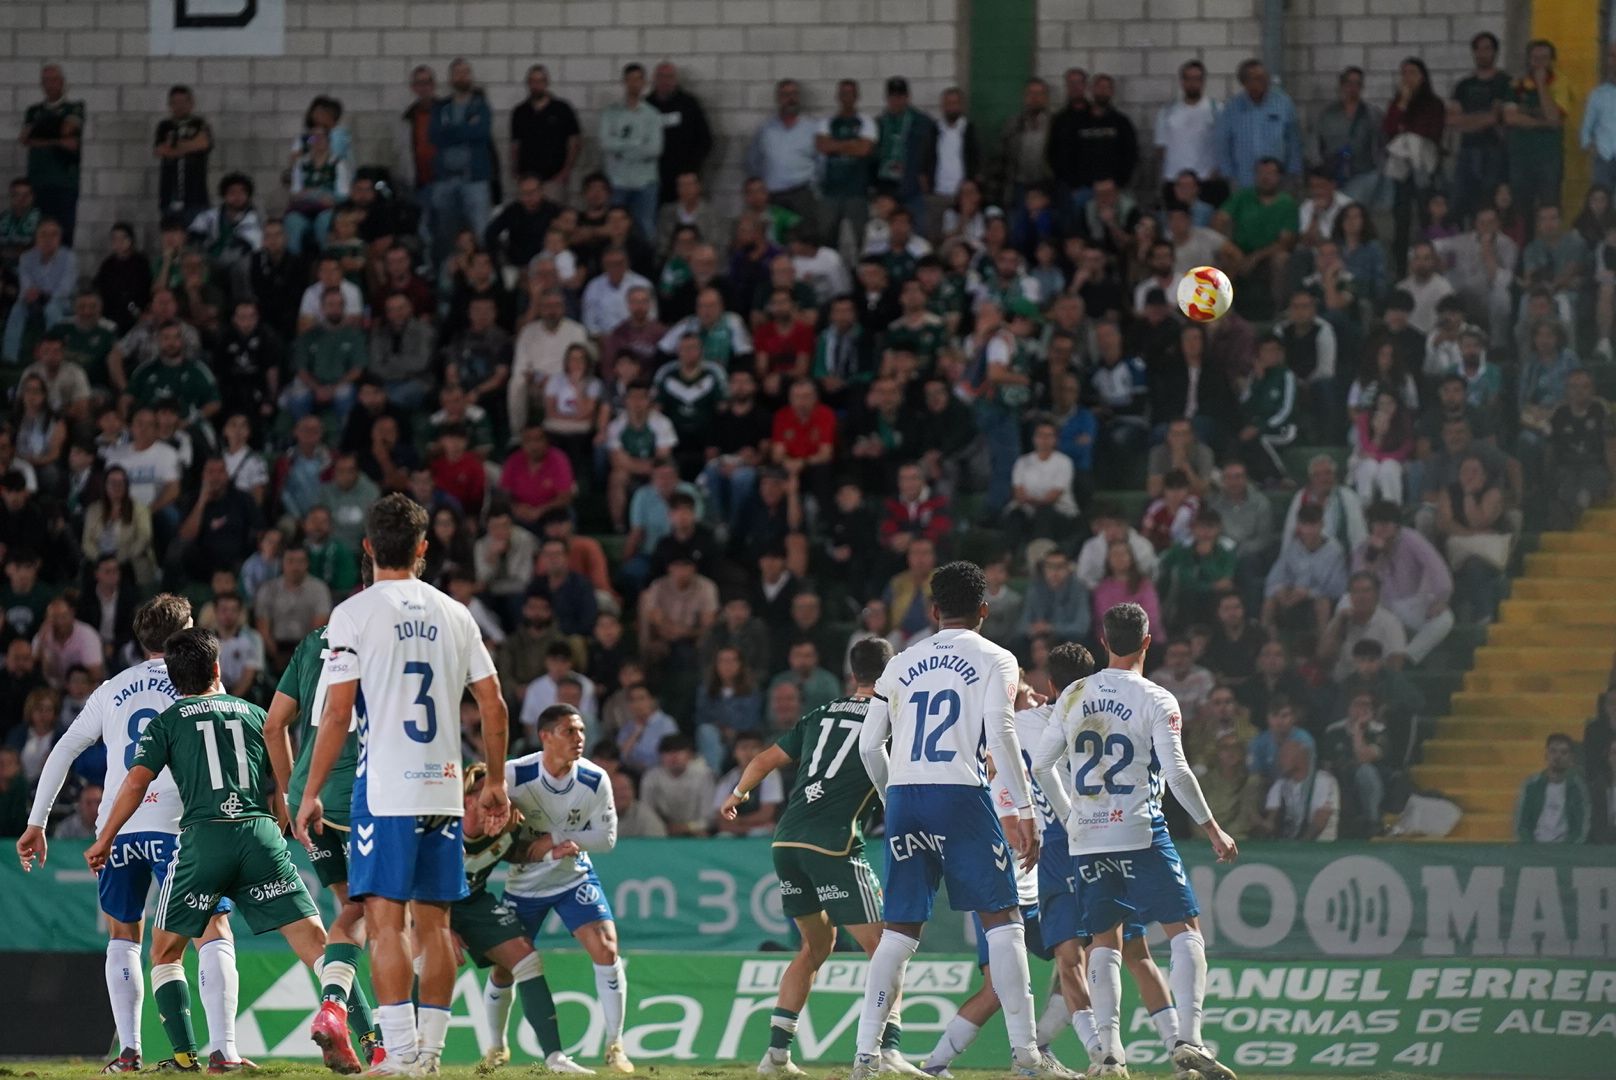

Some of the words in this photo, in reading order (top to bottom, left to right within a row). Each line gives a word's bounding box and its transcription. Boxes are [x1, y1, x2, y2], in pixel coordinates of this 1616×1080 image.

[394, 620, 438, 641] ZOILO
[899, 655, 979, 687] LANDAZURI
[113, 679, 144, 707] JAVI
[147, 676, 185, 701] PÉRE
[403, 661, 438, 744] 3
[1082, 699, 1132, 721] ÁLVARO
[909, 689, 961, 763] 12
[196, 719, 249, 790] 11
[807, 717, 863, 779] 17
[1075, 730, 1135, 796] 22
[818, 890, 849, 902] MEDIO
[750, 963, 966, 988] LIPIZAS
[1163, 966, 1392, 1001] ANUEL
[1129, 1007, 1401, 1036] RFORMAS
[1415, 1008, 1484, 1035] DE
[1233, 1041, 1298, 1067] 63
[1310, 1042, 1381, 1068] 42
[1393, 1042, 1444, 1067] 41
